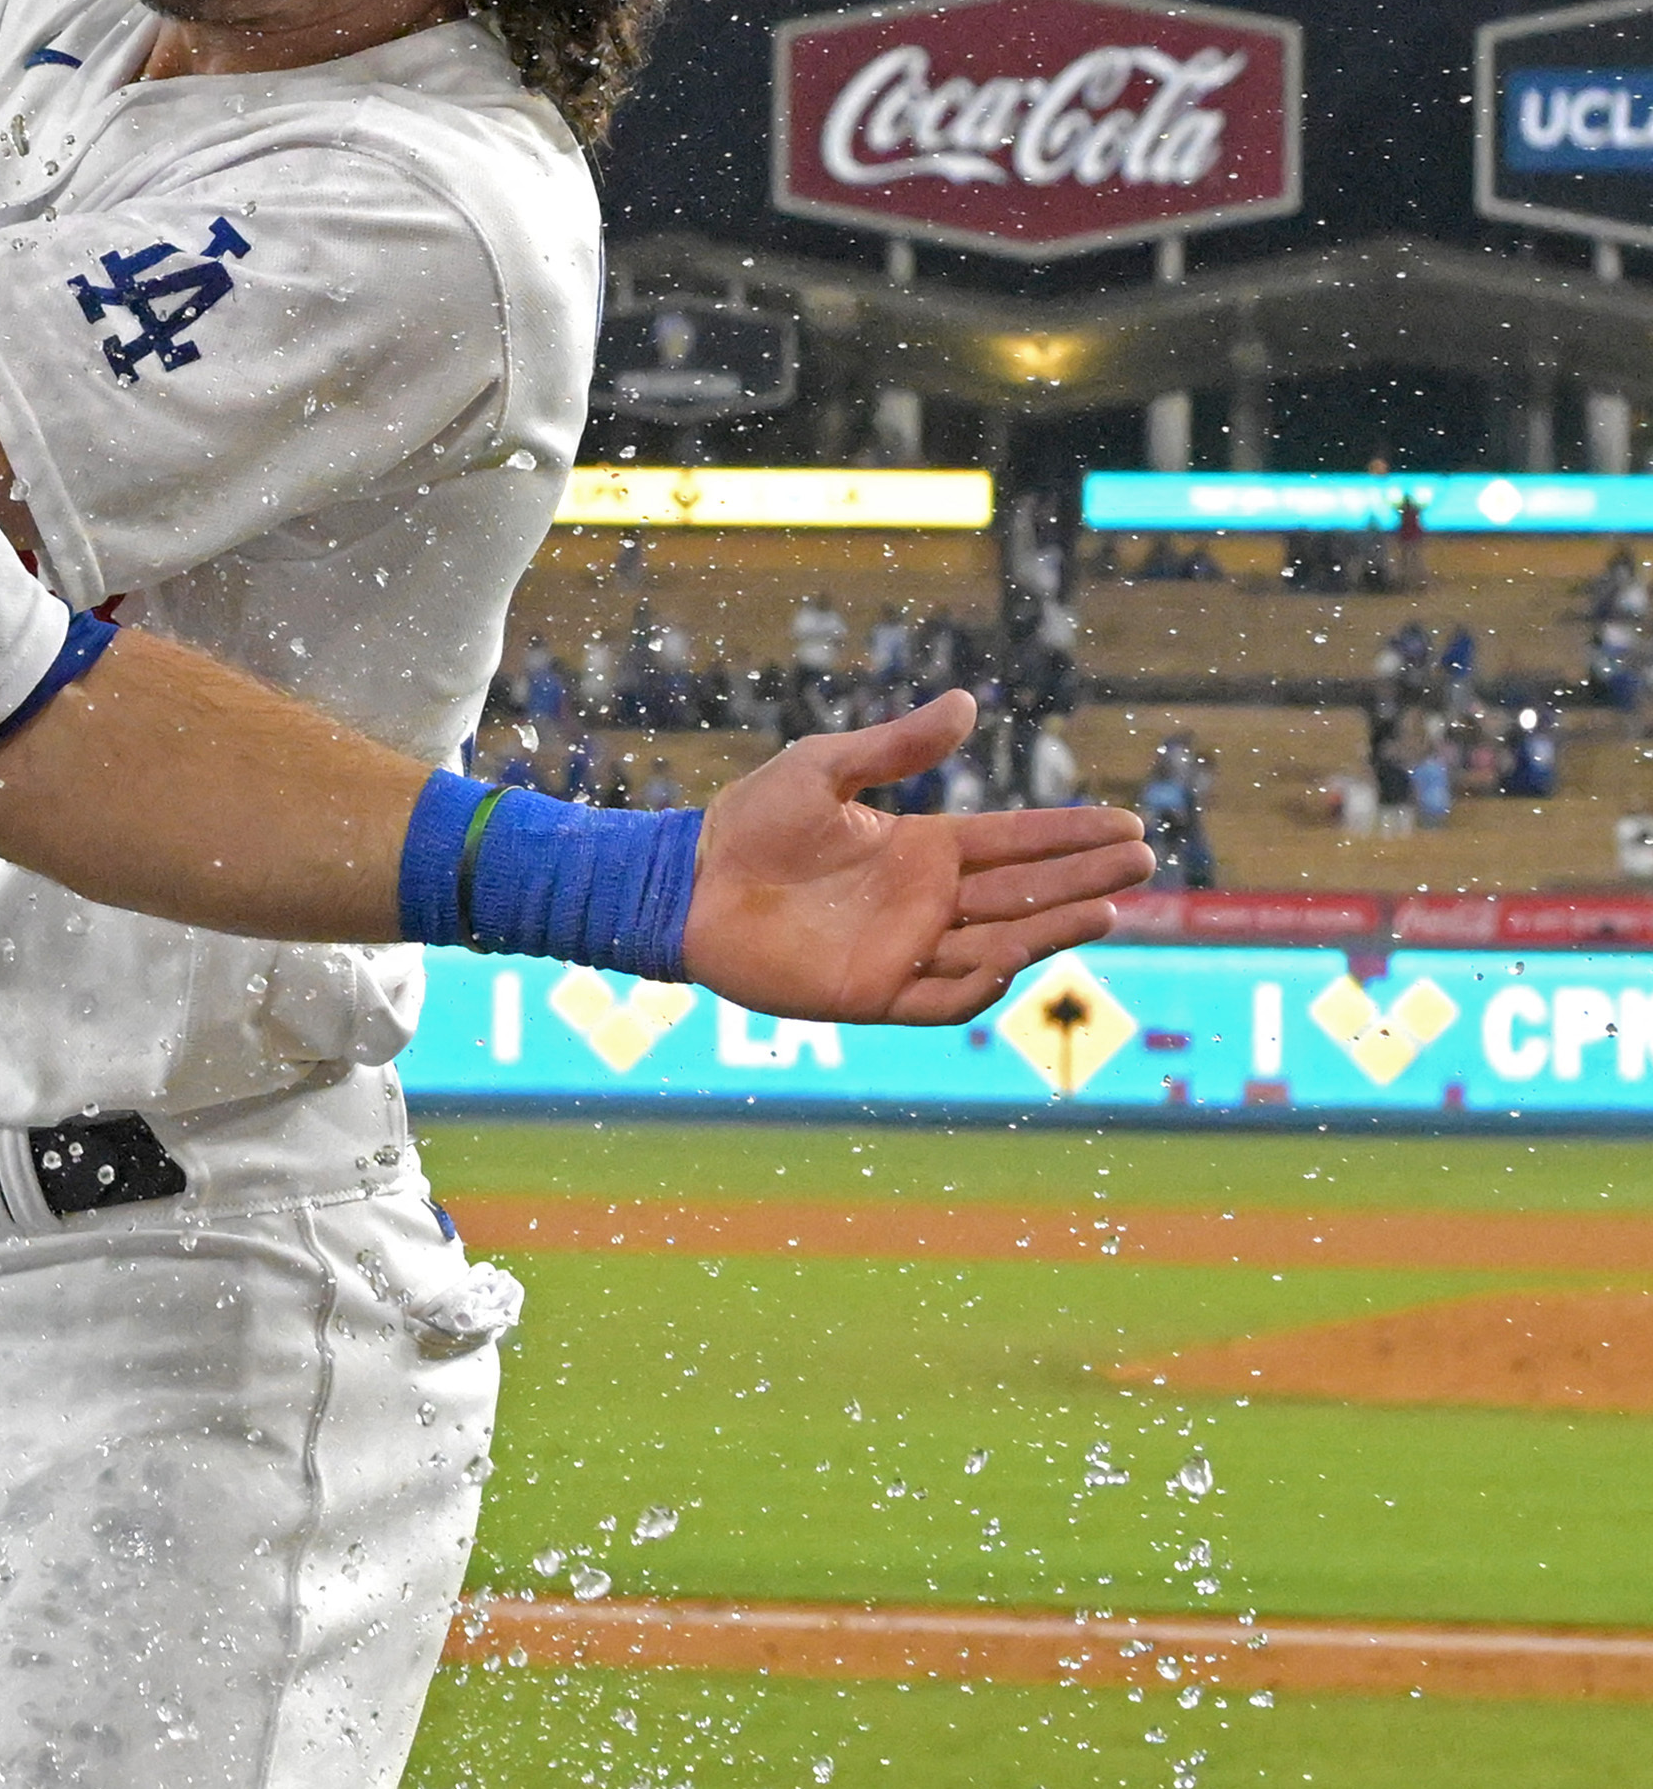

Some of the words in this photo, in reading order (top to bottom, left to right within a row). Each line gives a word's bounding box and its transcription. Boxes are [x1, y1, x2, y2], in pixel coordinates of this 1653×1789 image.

[1519, 86, 1653, 150] UCL
[67, 216, 252, 387] LA
[492, 970, 523, 1064] I
[1252, 981, 1283, 1076] I
